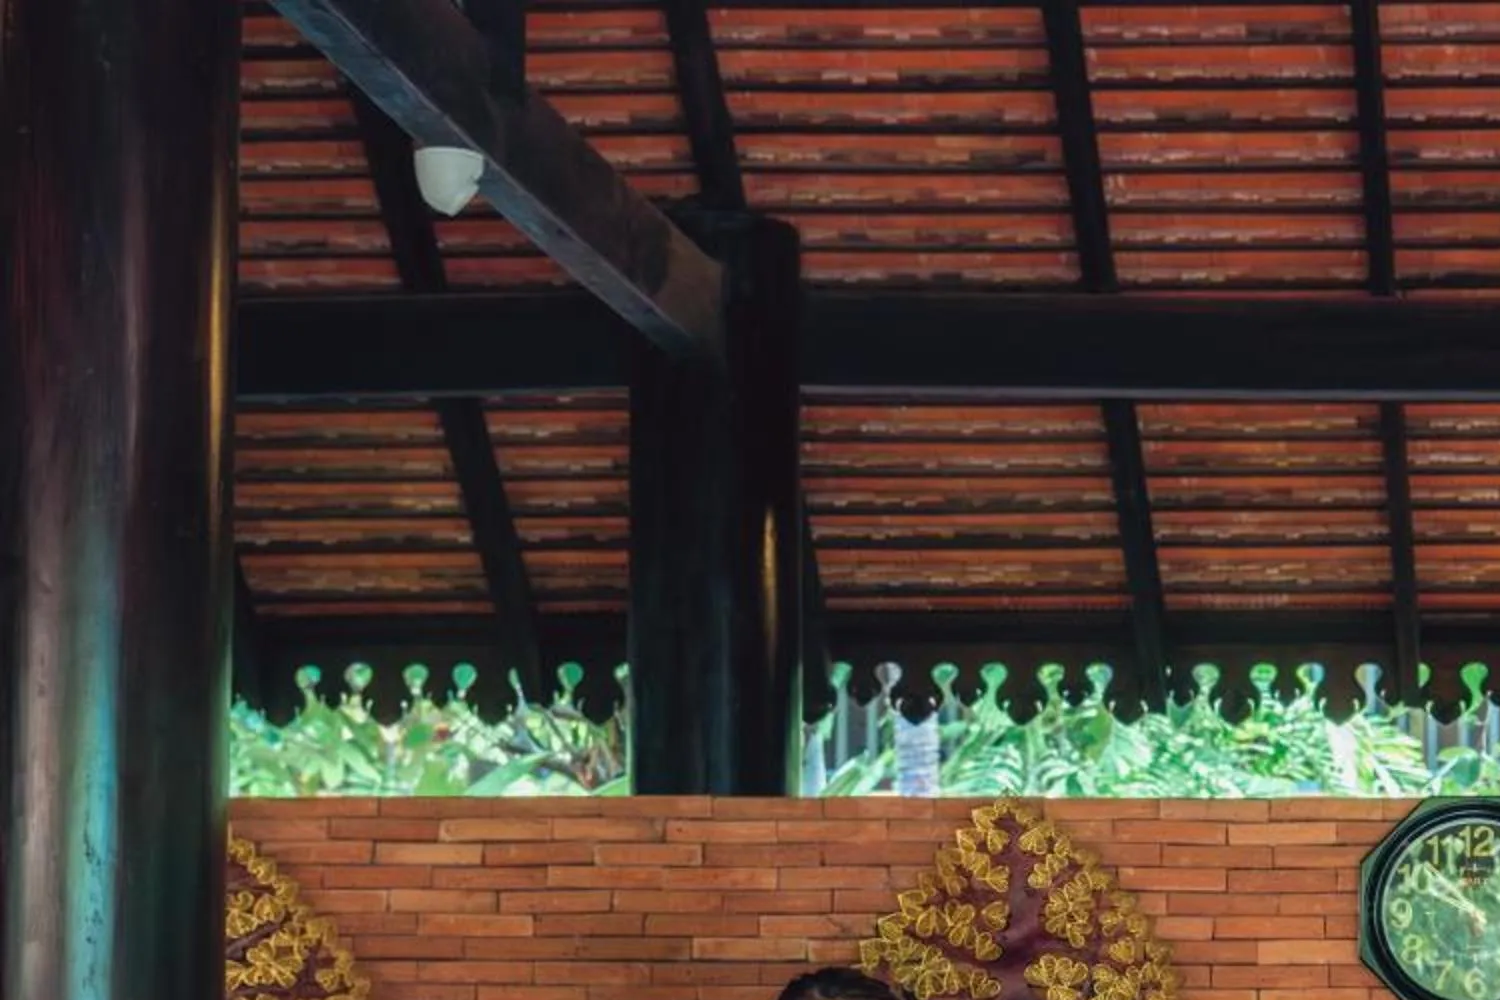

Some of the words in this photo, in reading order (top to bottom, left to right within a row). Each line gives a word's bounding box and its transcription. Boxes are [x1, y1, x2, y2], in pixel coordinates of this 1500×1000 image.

[1427, 835, 1456, 873] 11
[1458, 825, 1496, 857] 12
[1396, 863, 1431, 892] 10
[1389, 897, 1413, 930] 9
[1400, 935, 1423, 964] 8
[1436, 960, 1455, 992] 7
[1463, 966, 1487, 1000] 6
